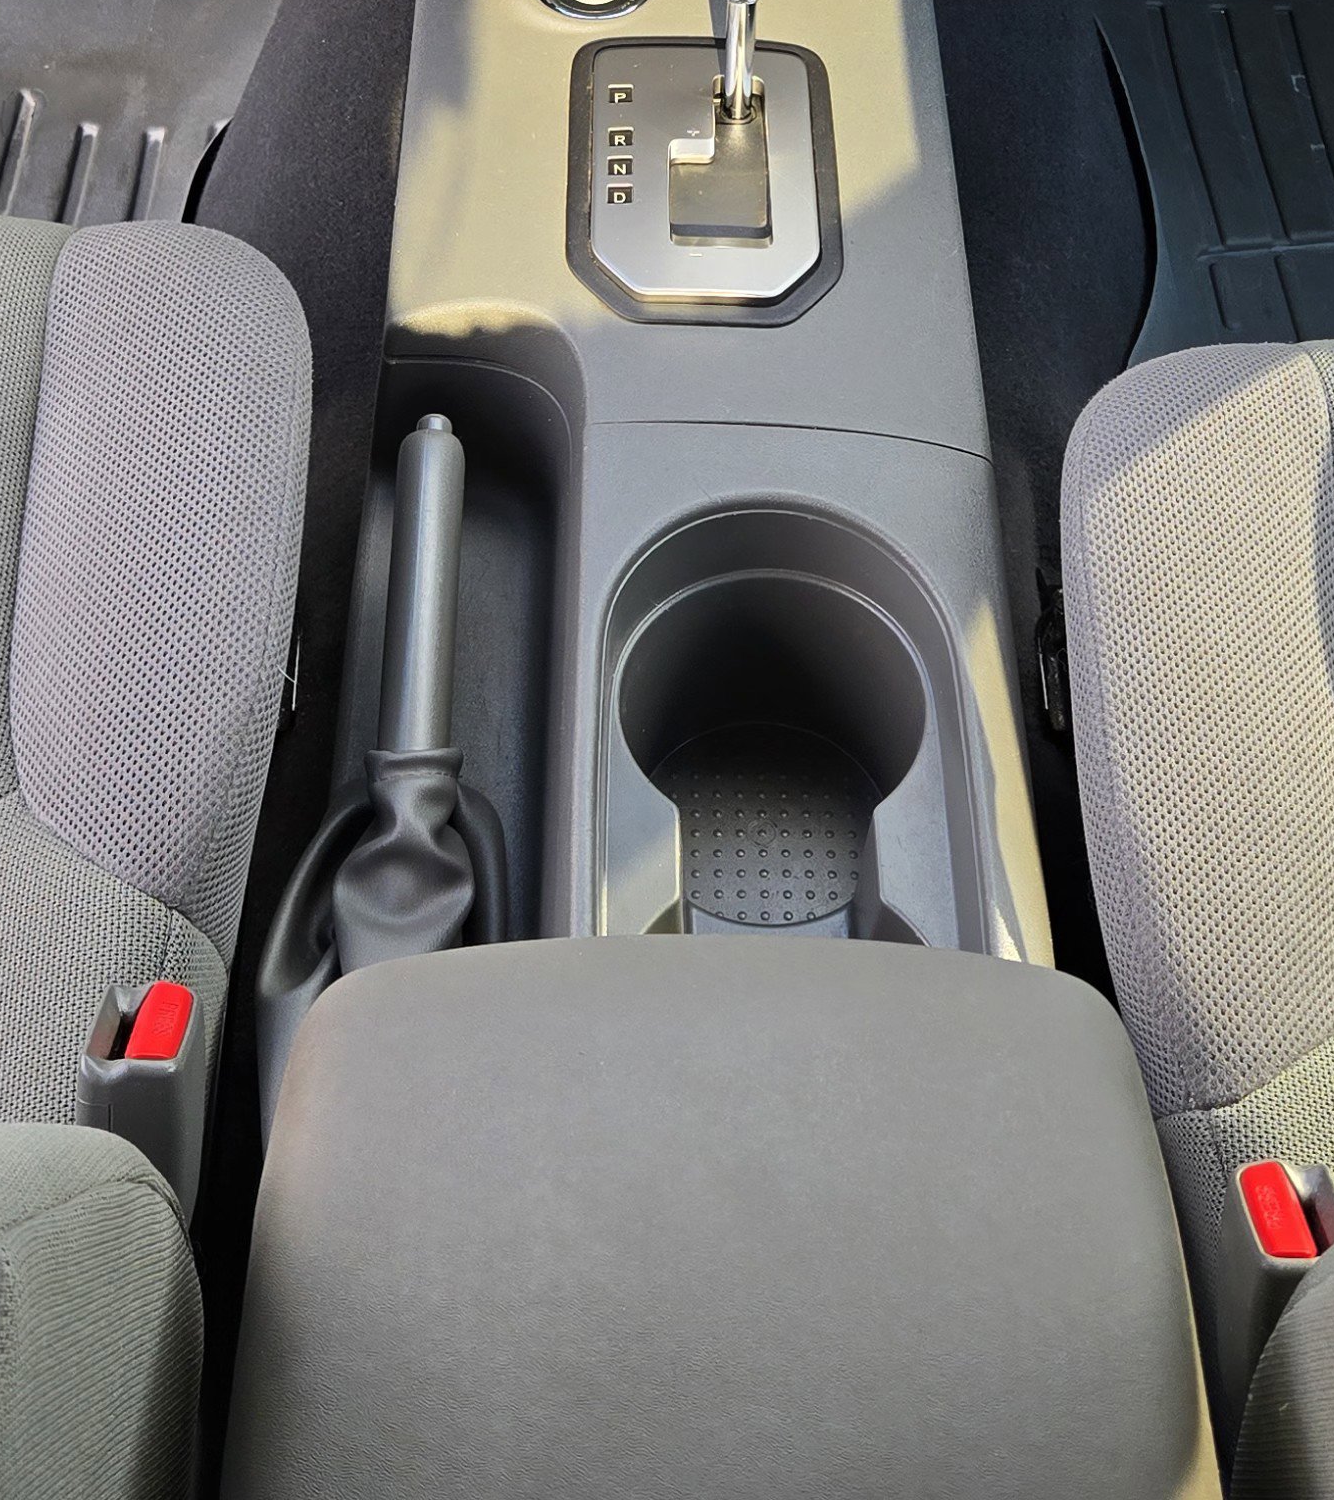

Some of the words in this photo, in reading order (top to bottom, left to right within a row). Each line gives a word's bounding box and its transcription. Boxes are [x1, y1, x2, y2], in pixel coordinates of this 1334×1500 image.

[614, 92, 627, 104] P
[614, 135, 626, 146] R
[613, 163, 627, 175] N
[613, 192, 627, 204] D
